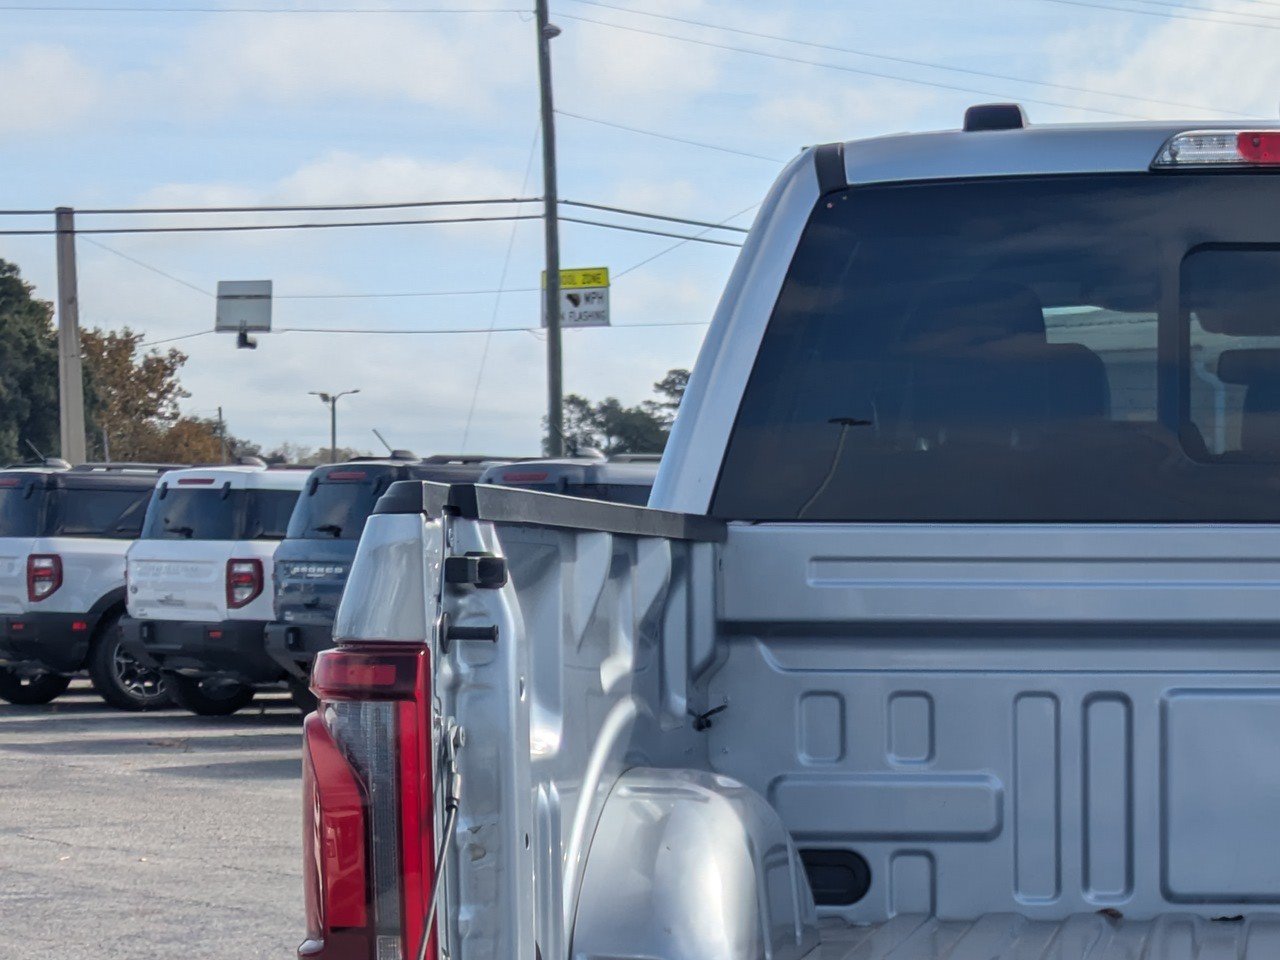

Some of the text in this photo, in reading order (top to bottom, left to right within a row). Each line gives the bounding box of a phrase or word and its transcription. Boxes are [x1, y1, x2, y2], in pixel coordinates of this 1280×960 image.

[582, 272, 602, 285] ZONE
[584, 292, 603, 304] MPH
[568, 310, 606, 322] FLASHING
